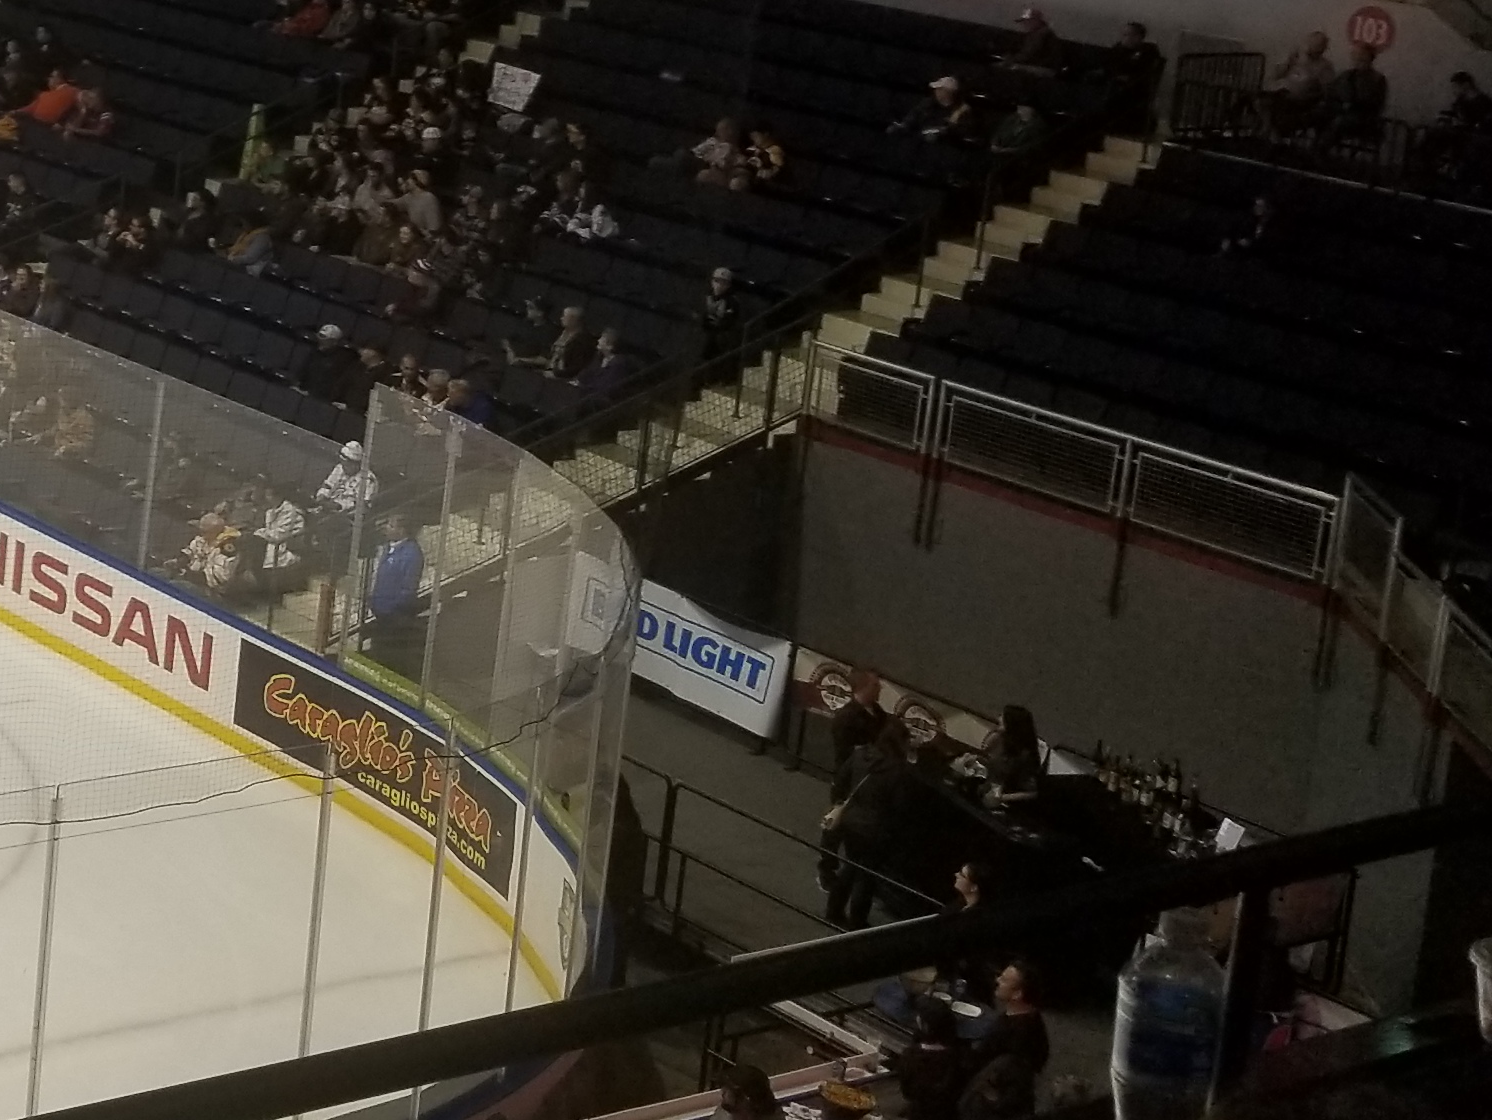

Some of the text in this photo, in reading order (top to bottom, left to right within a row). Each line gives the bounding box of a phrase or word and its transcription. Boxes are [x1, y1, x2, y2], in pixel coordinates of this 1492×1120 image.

[1353, 16, 1390, 45] 103
[663, 619, 767, 691] LIGHT
[263, 673, 417, 784] Caraglio's
[357, 769, 487, 870] caragliospza.com
